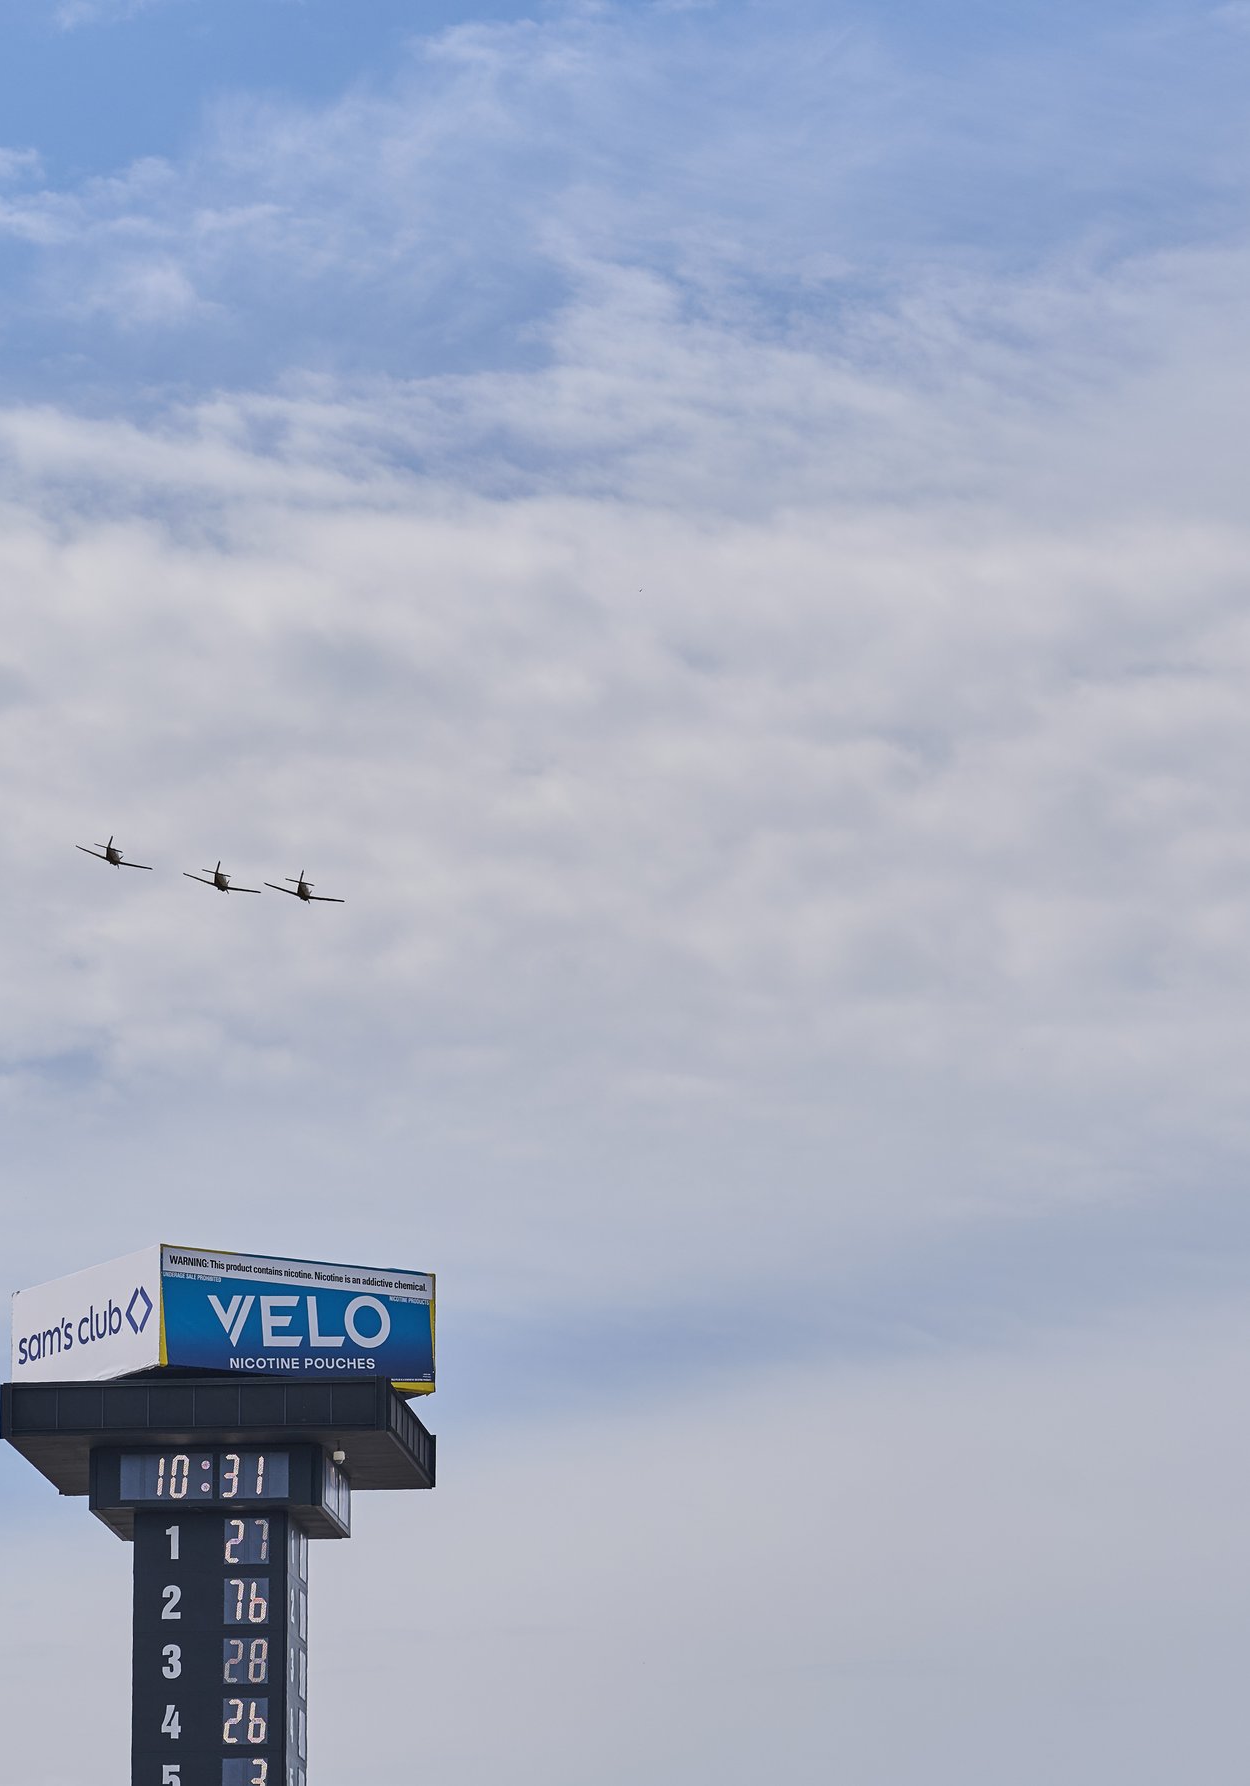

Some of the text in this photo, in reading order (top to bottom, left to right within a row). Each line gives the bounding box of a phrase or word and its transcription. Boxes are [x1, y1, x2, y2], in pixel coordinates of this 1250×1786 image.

[169, 1254, 428, 1292] WARNING: This product contains nicotine. Nicotine is an addictive chemical.
[18, 1299, 122, 1365] sam's club
[207, 1294, 391, 1349] VELO
[229, 1357, 376, 1370] NICOTINE POUCHES
[165, 1525, 180, 1560] 1
[224, 1519, 269, 1564] 27
[161, 1584, 182, 1620] 2
[229, 1579, 268, 1623] 76
[161, 1644, 182, 1679] 3
[223, 1639, 268, 1683] 28
[161, 1704, 182, 1739] 4
[222, 1698, 267, 1743] 26
[161, 1764, 181, 1786] 5
[250, 1757, 268, 1786] 3
